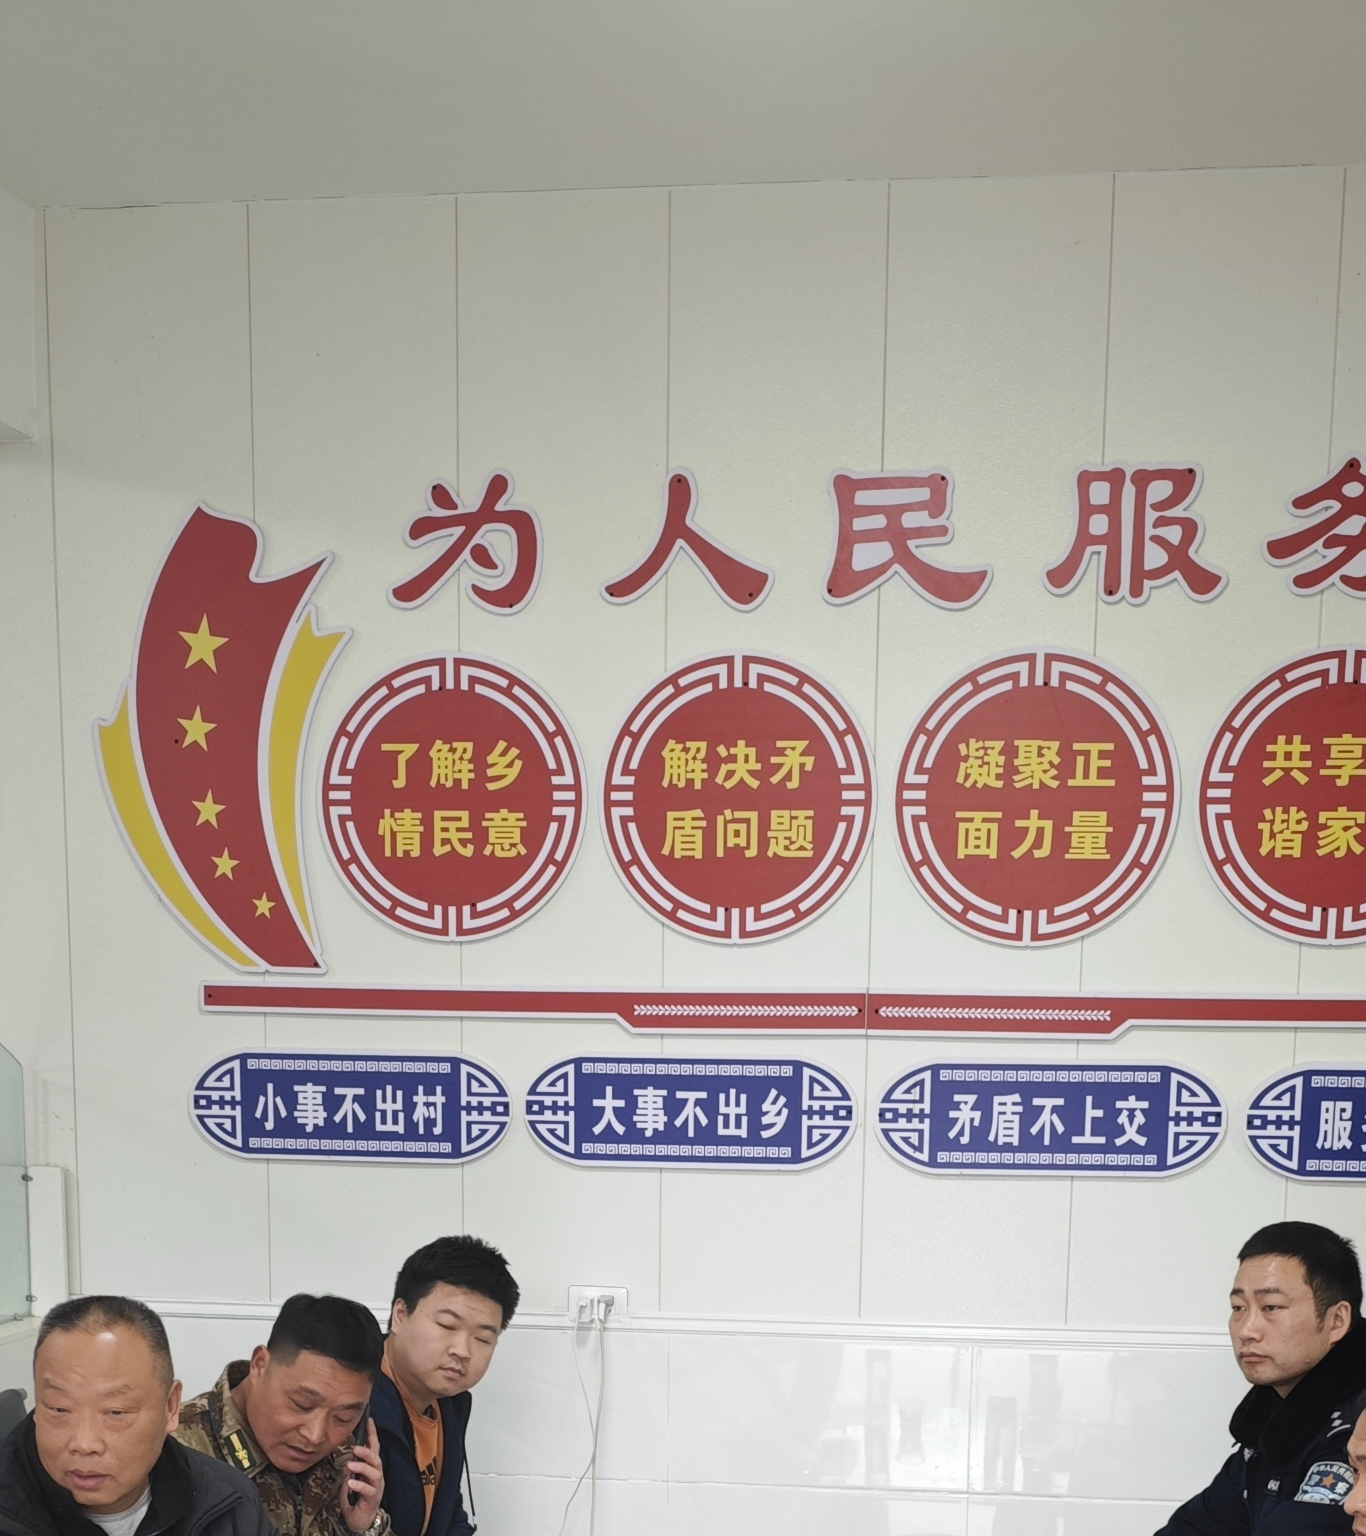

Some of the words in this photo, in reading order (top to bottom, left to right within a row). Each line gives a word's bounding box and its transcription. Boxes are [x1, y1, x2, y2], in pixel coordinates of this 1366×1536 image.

[379, 741, 525, 791] 了解乡
[661, 740, 815, 790] 解决矛
[956, 738, 1116, 789] 凝聚正
[378, 809, 528, 858] 情民意
[661, 809, 815, 860] 盾问题
[956, 810, 1114, 860] 面力量
[253, 1082, 447, 1137] 小事不出村
[590, 1086, 790, 1139] 大事不出乡
[947, 1091, 1149, 1147] 矛盾不上交
